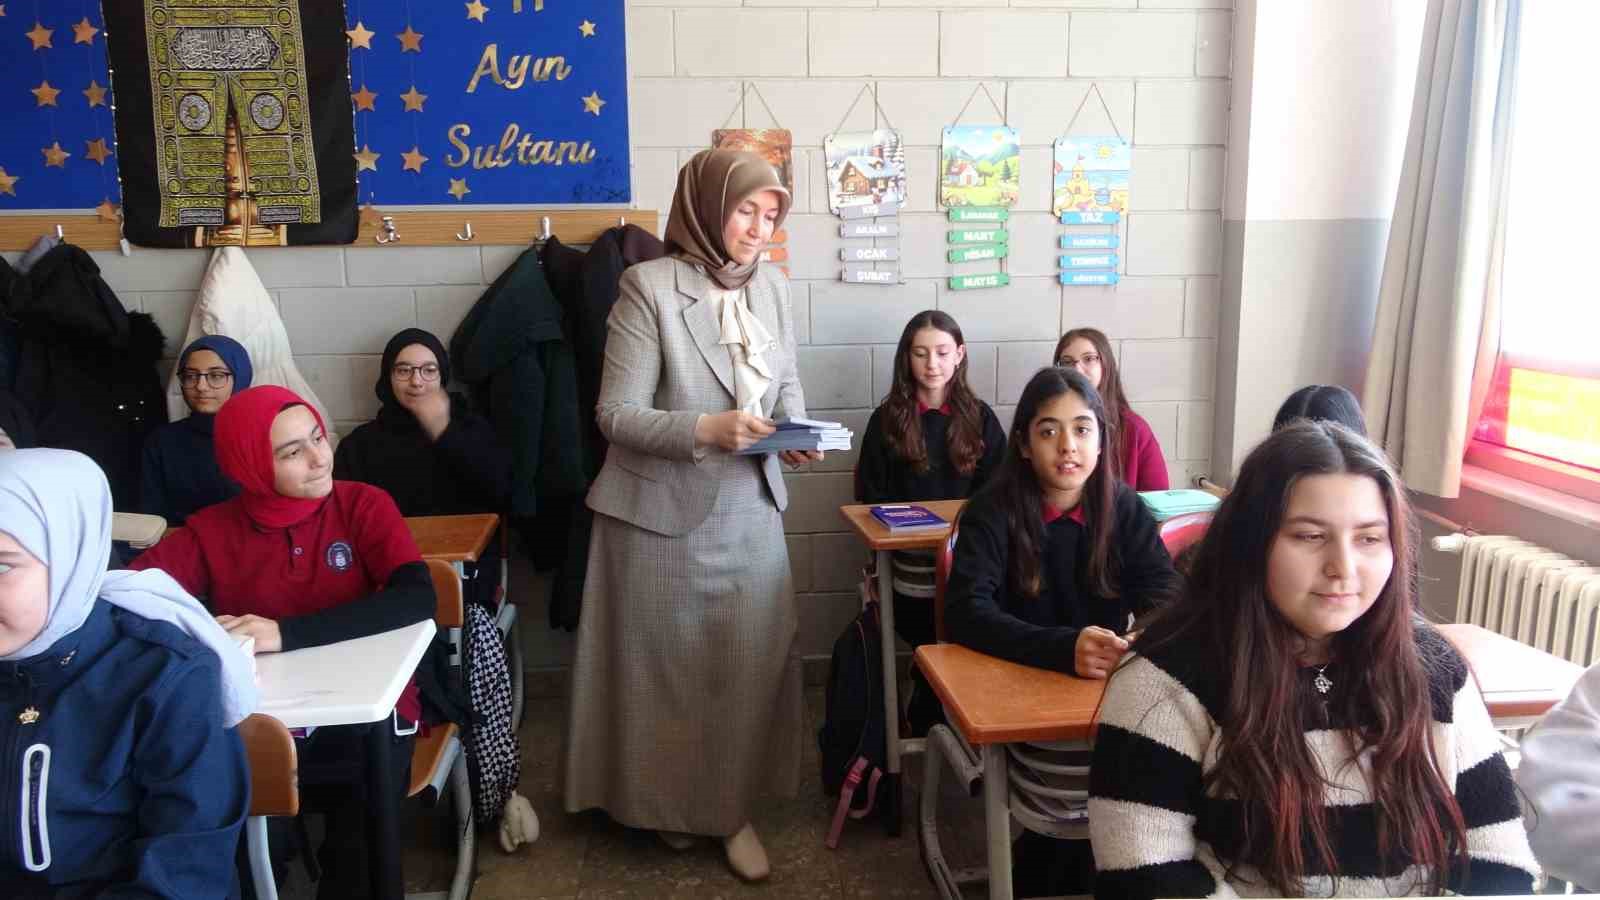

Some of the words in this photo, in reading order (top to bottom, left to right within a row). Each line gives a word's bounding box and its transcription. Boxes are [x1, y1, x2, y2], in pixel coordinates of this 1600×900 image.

[465, 43, 573, 93] Ayın
[445, 123, 596, 169] Sultanı
[856, 248, 888, 260] OCAK
